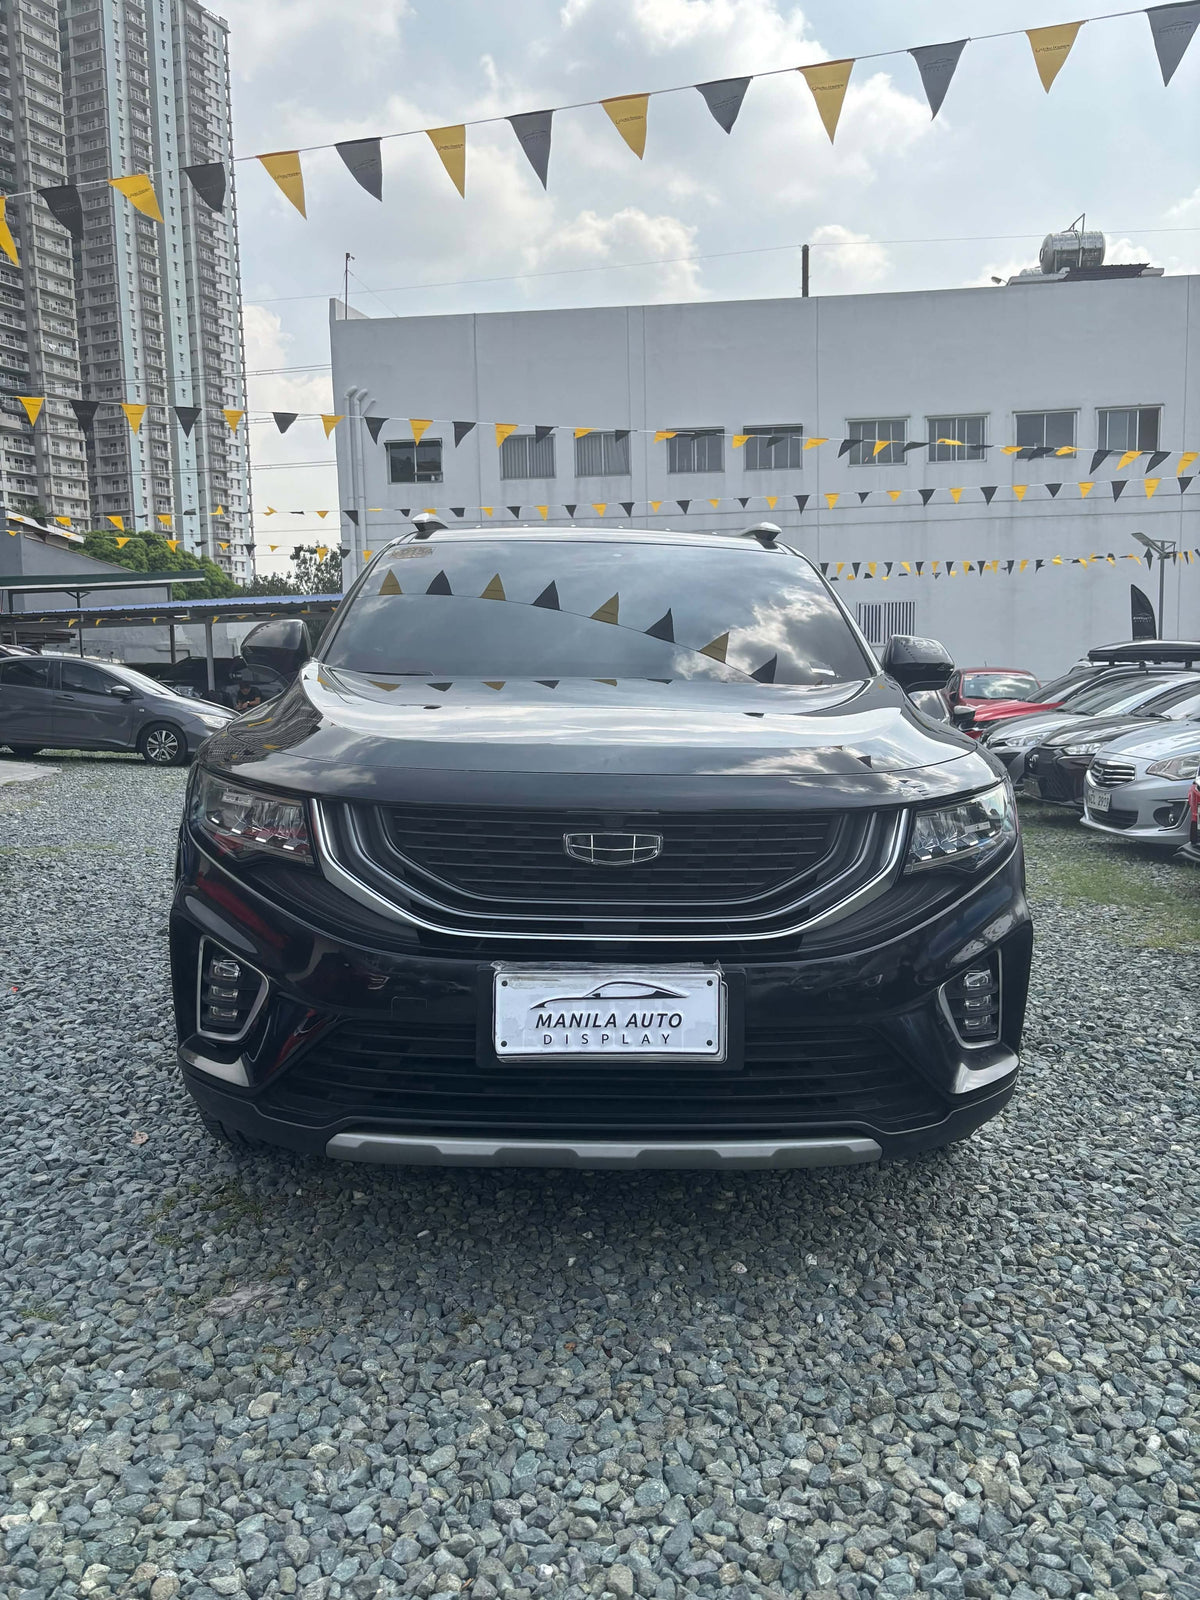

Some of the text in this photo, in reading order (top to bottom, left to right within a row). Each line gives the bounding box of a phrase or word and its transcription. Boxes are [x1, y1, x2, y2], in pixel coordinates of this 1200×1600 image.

[535, 1012, 683, 1029] MANILA AUTO
[543, 1033, 670, 1045] DISPLAY
